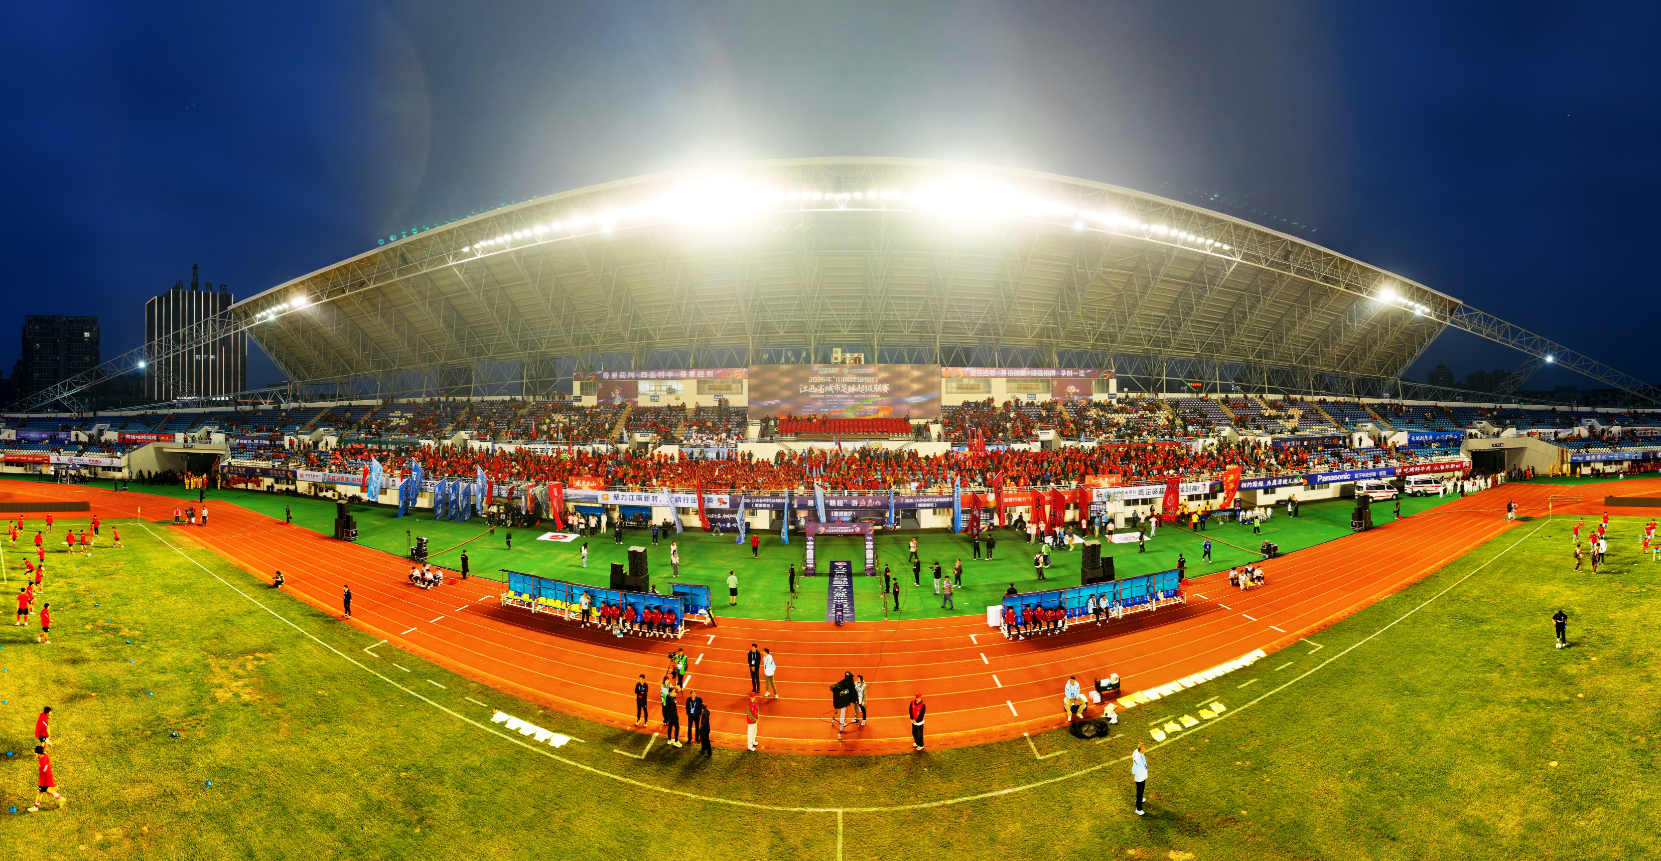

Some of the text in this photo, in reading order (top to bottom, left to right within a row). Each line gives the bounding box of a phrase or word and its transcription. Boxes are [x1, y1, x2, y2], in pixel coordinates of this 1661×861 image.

[799, 383, 891, 394] 江西省城市足球超级联赛
[1317, 472, 1351, 482] Panasonic
